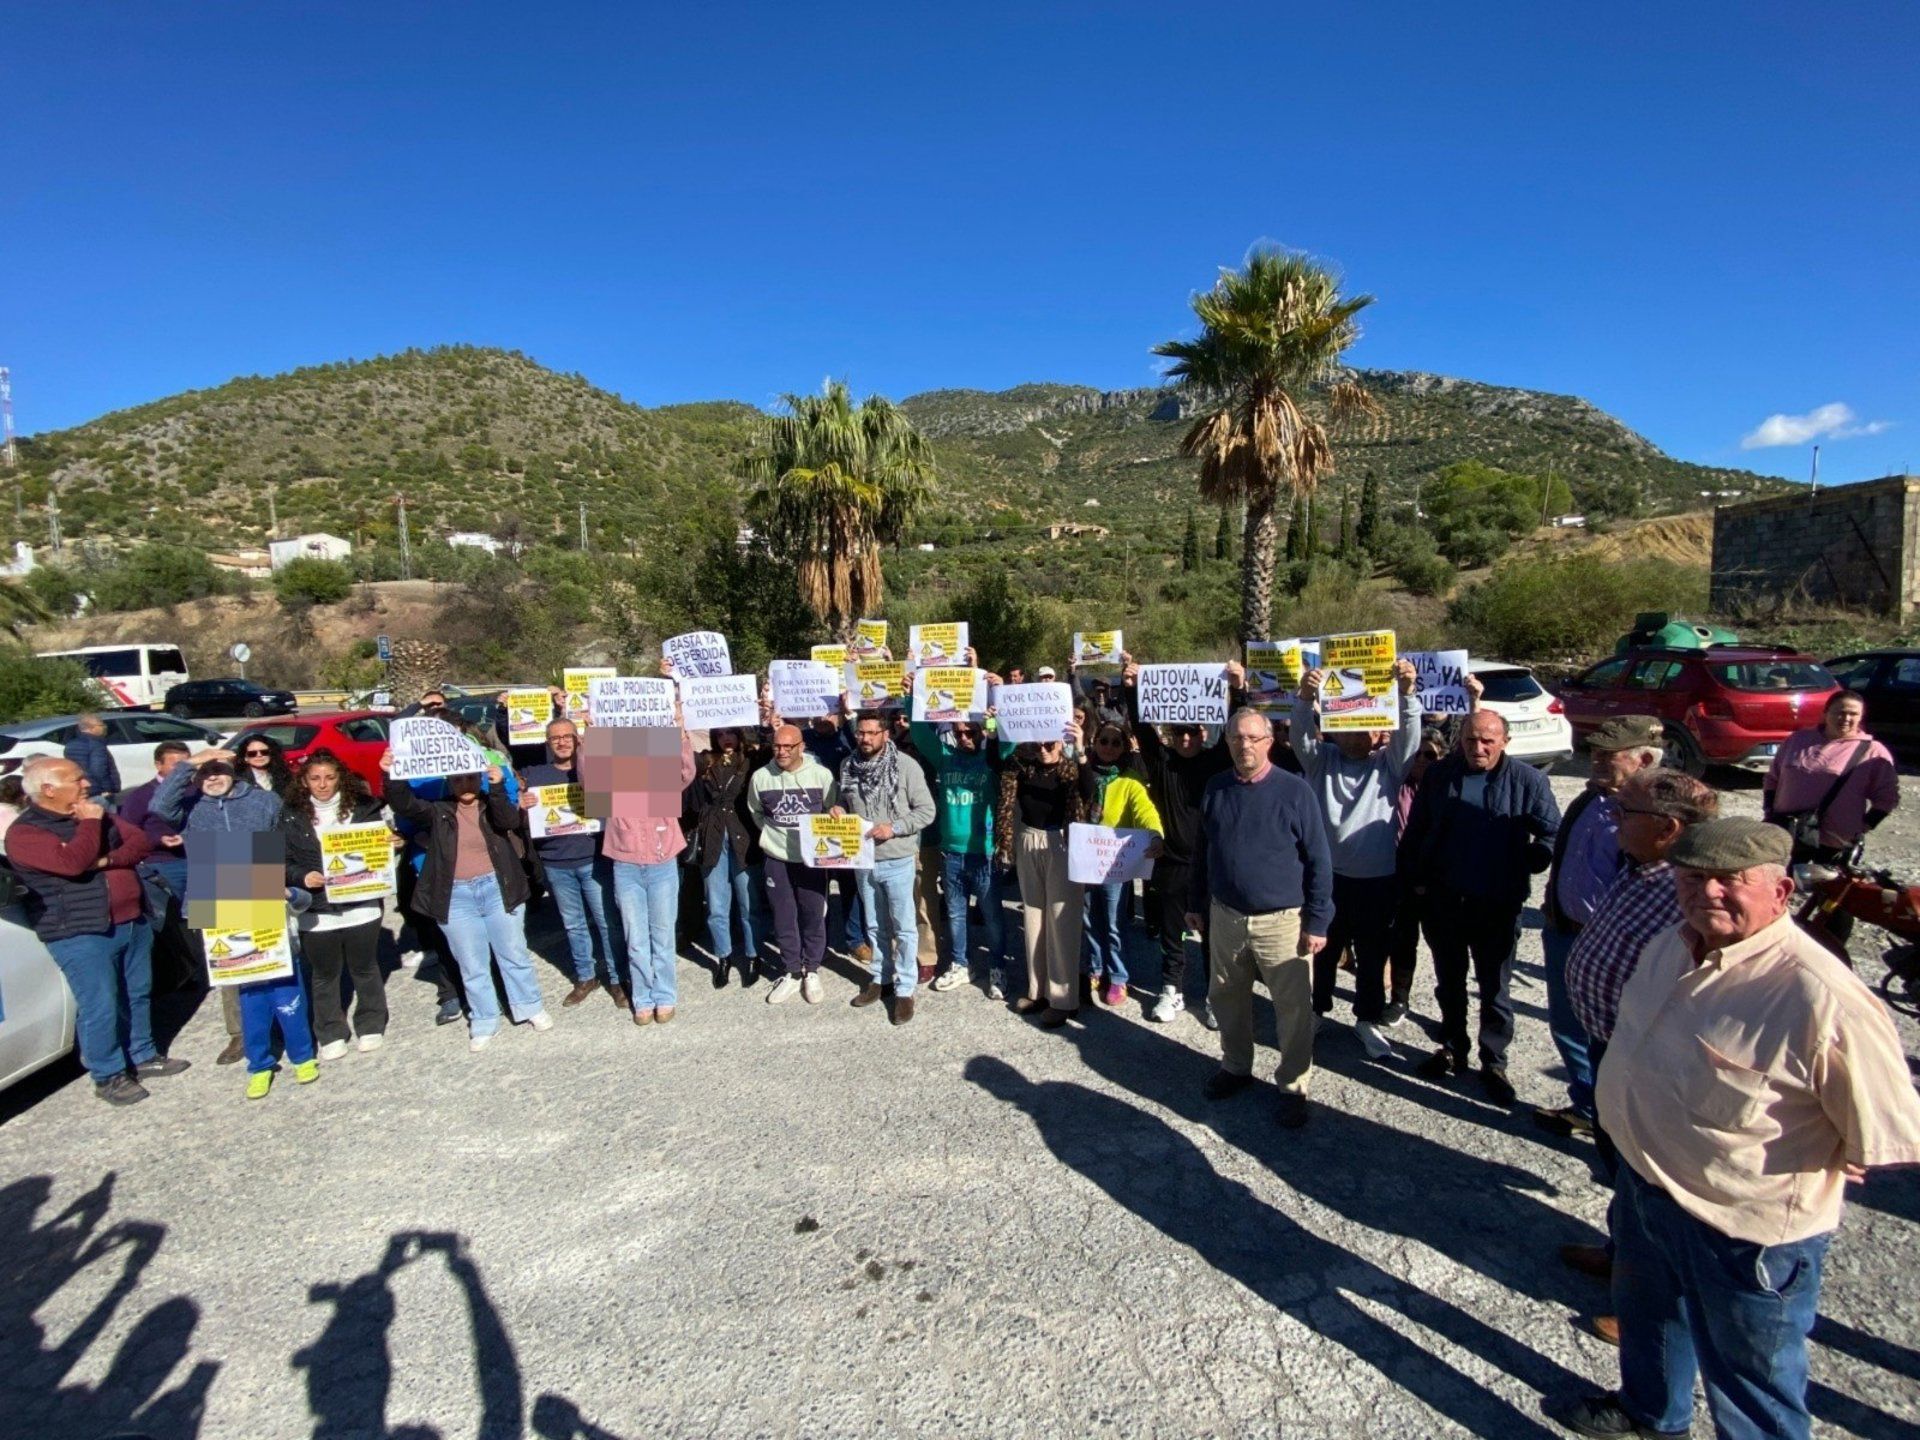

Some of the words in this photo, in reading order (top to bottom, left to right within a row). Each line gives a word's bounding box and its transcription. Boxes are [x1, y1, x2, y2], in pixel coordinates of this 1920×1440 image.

[670, 634, 702, 652] BASTA
[704, 634, 718, 645] YA
[679, 665, 694, 677] DE
[1141, 665, 1200, 686] AUTOVÍA
[623, 681, 666, 695] PROMESAS
[691, 684, 713, 695] POR
[715, 682, 746, 693] UNAS
[1142, 687, 1188, 703] ARCOS
[1200, 677, 1226, 700] ¡YA!
[686, 695, 753, 707] CARRETERAS
[1002, 693, 1025, 704] POR
[1027, 691, 1060, 703] UNAS
[596, 699, 647, 714] INCUMPLIDAS
[661, 697, 673, 711] LA
[696, 707, 744, 718] DIGNAS!!
[997, 704, 1067, 717] CARRETERAS
[1143, 705, 1226, 722] ANTEQUERA
[1008, 718, 1058, 730] DIGNAS!!
[410, 735, 470, 756] NUESTRAS
[394, 753, 470, 776] CARRETERAS
